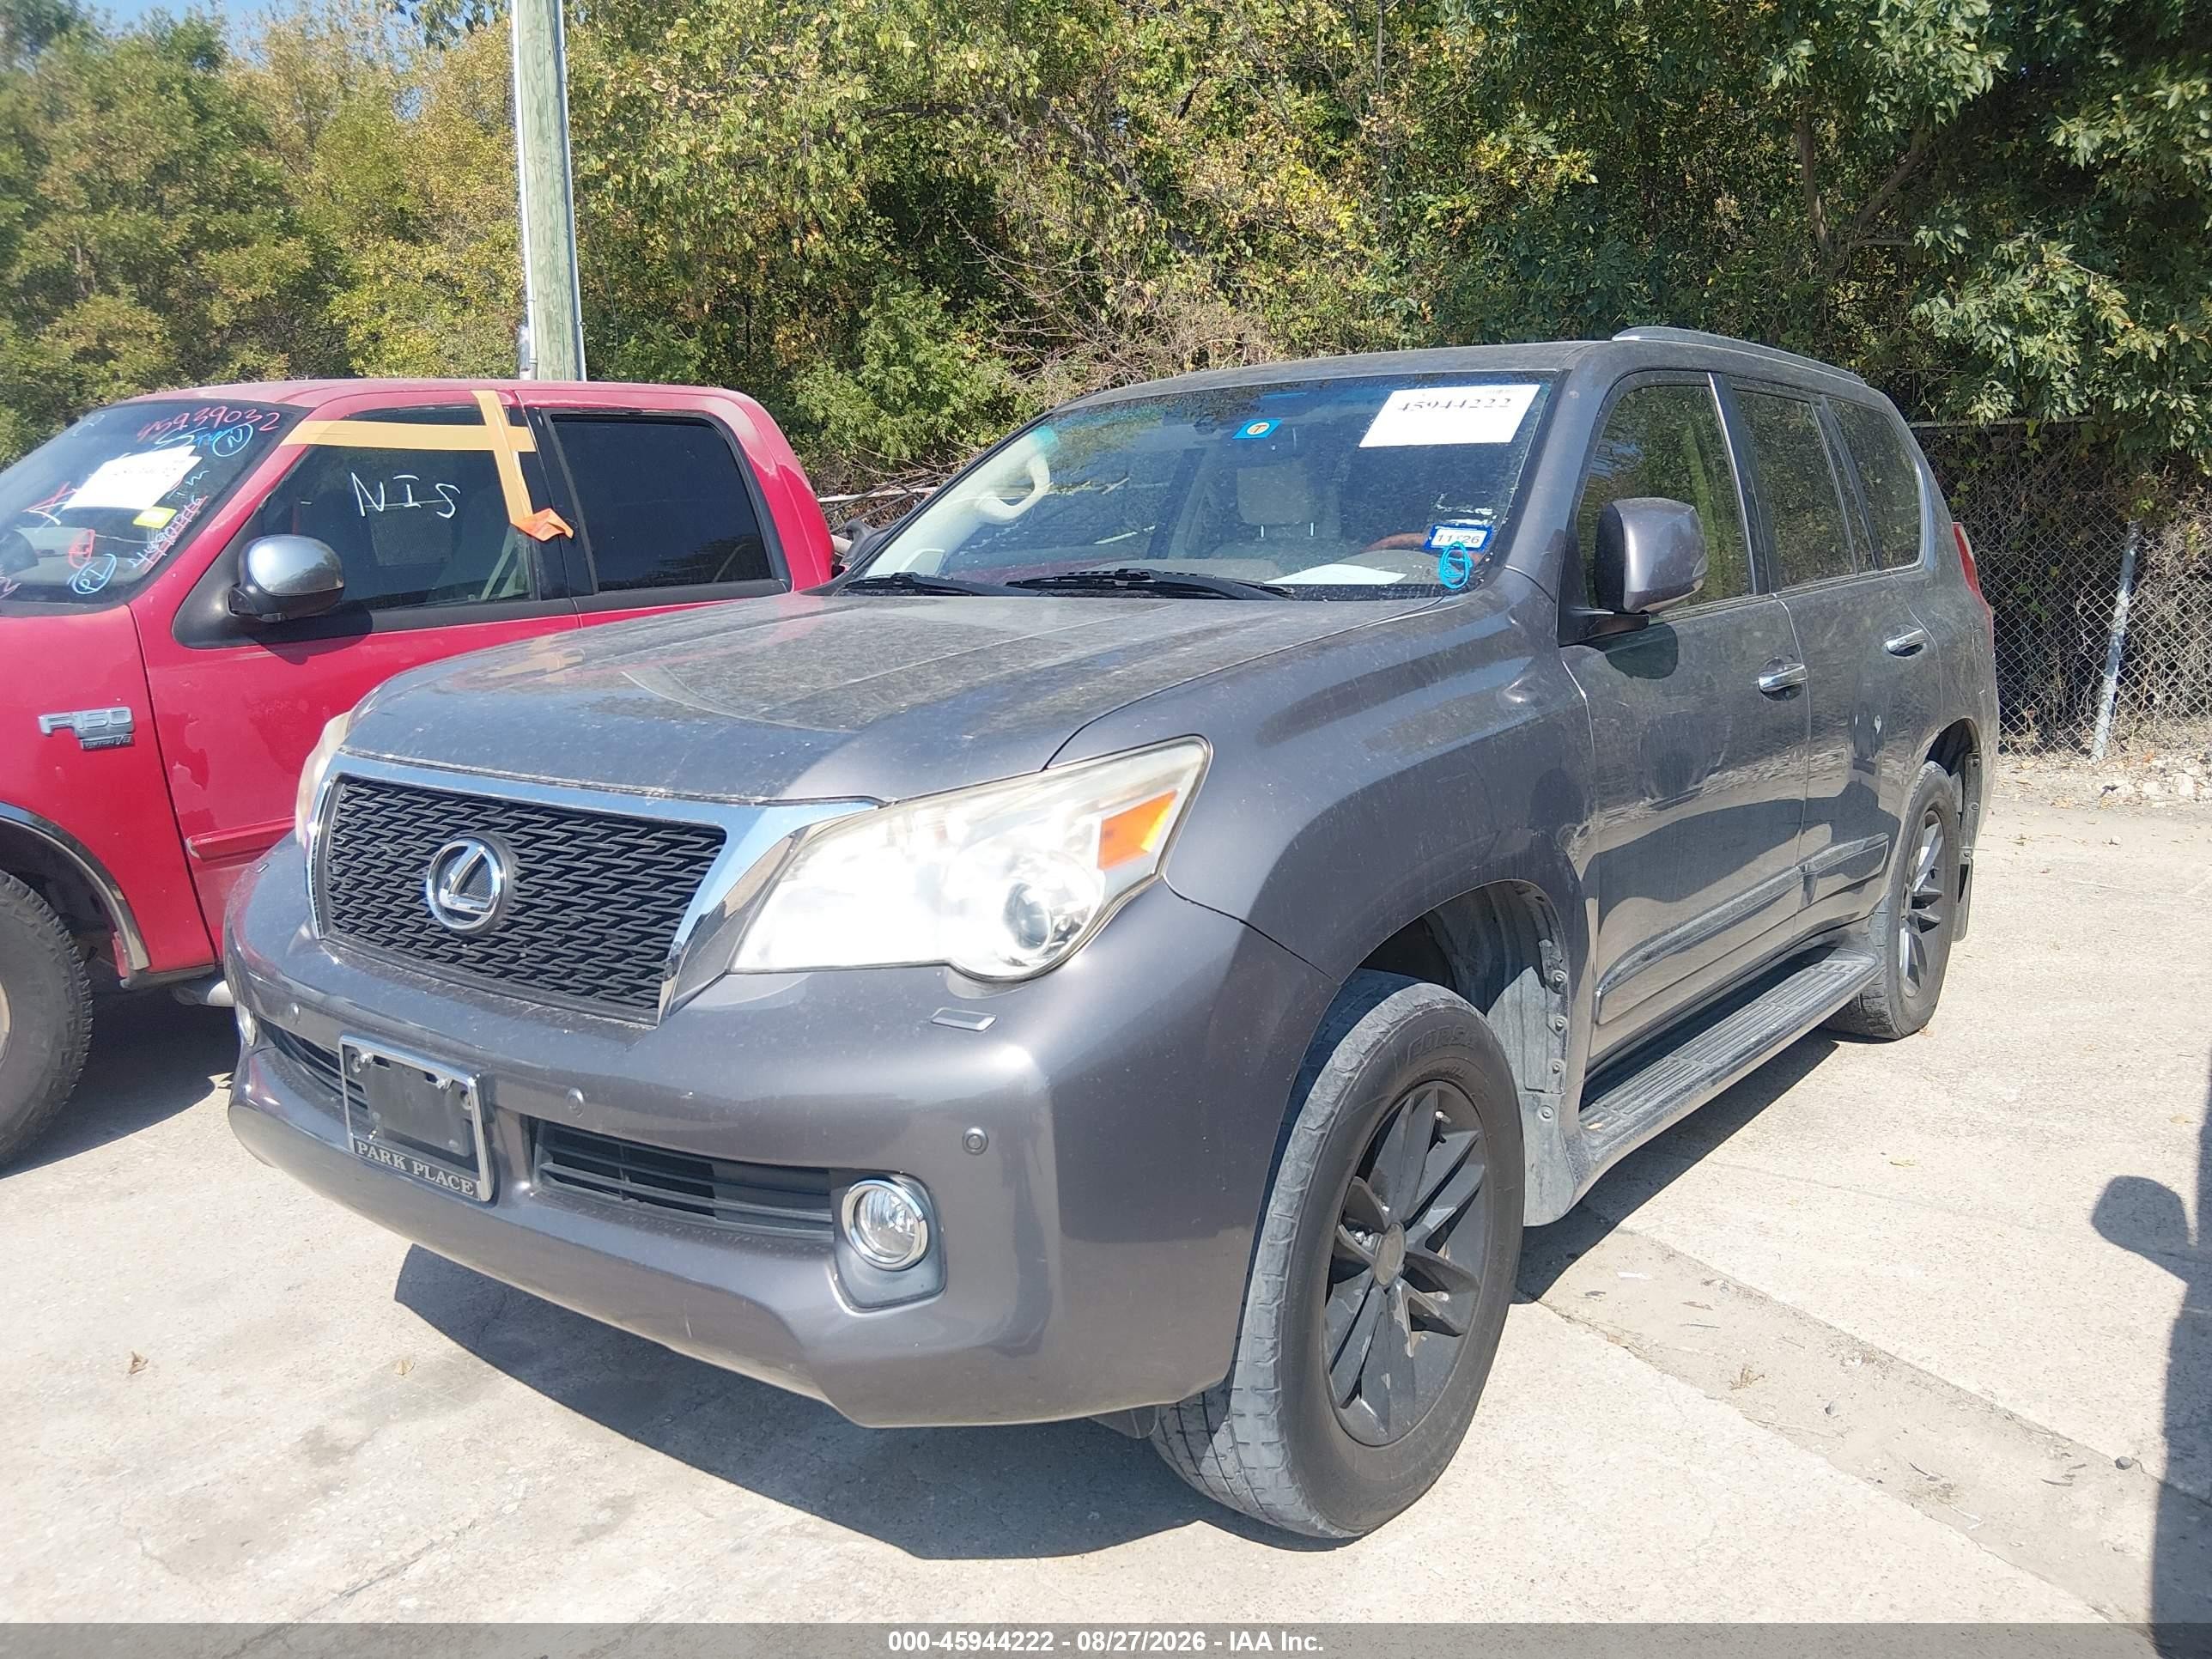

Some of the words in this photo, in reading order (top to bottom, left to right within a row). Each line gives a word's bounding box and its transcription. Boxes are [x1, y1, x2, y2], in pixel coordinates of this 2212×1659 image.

[350, 472, 460, 519] NIS
[357, 1139, 407, 1171] PARK
[411, 1160, 475, 1196] PLACE
